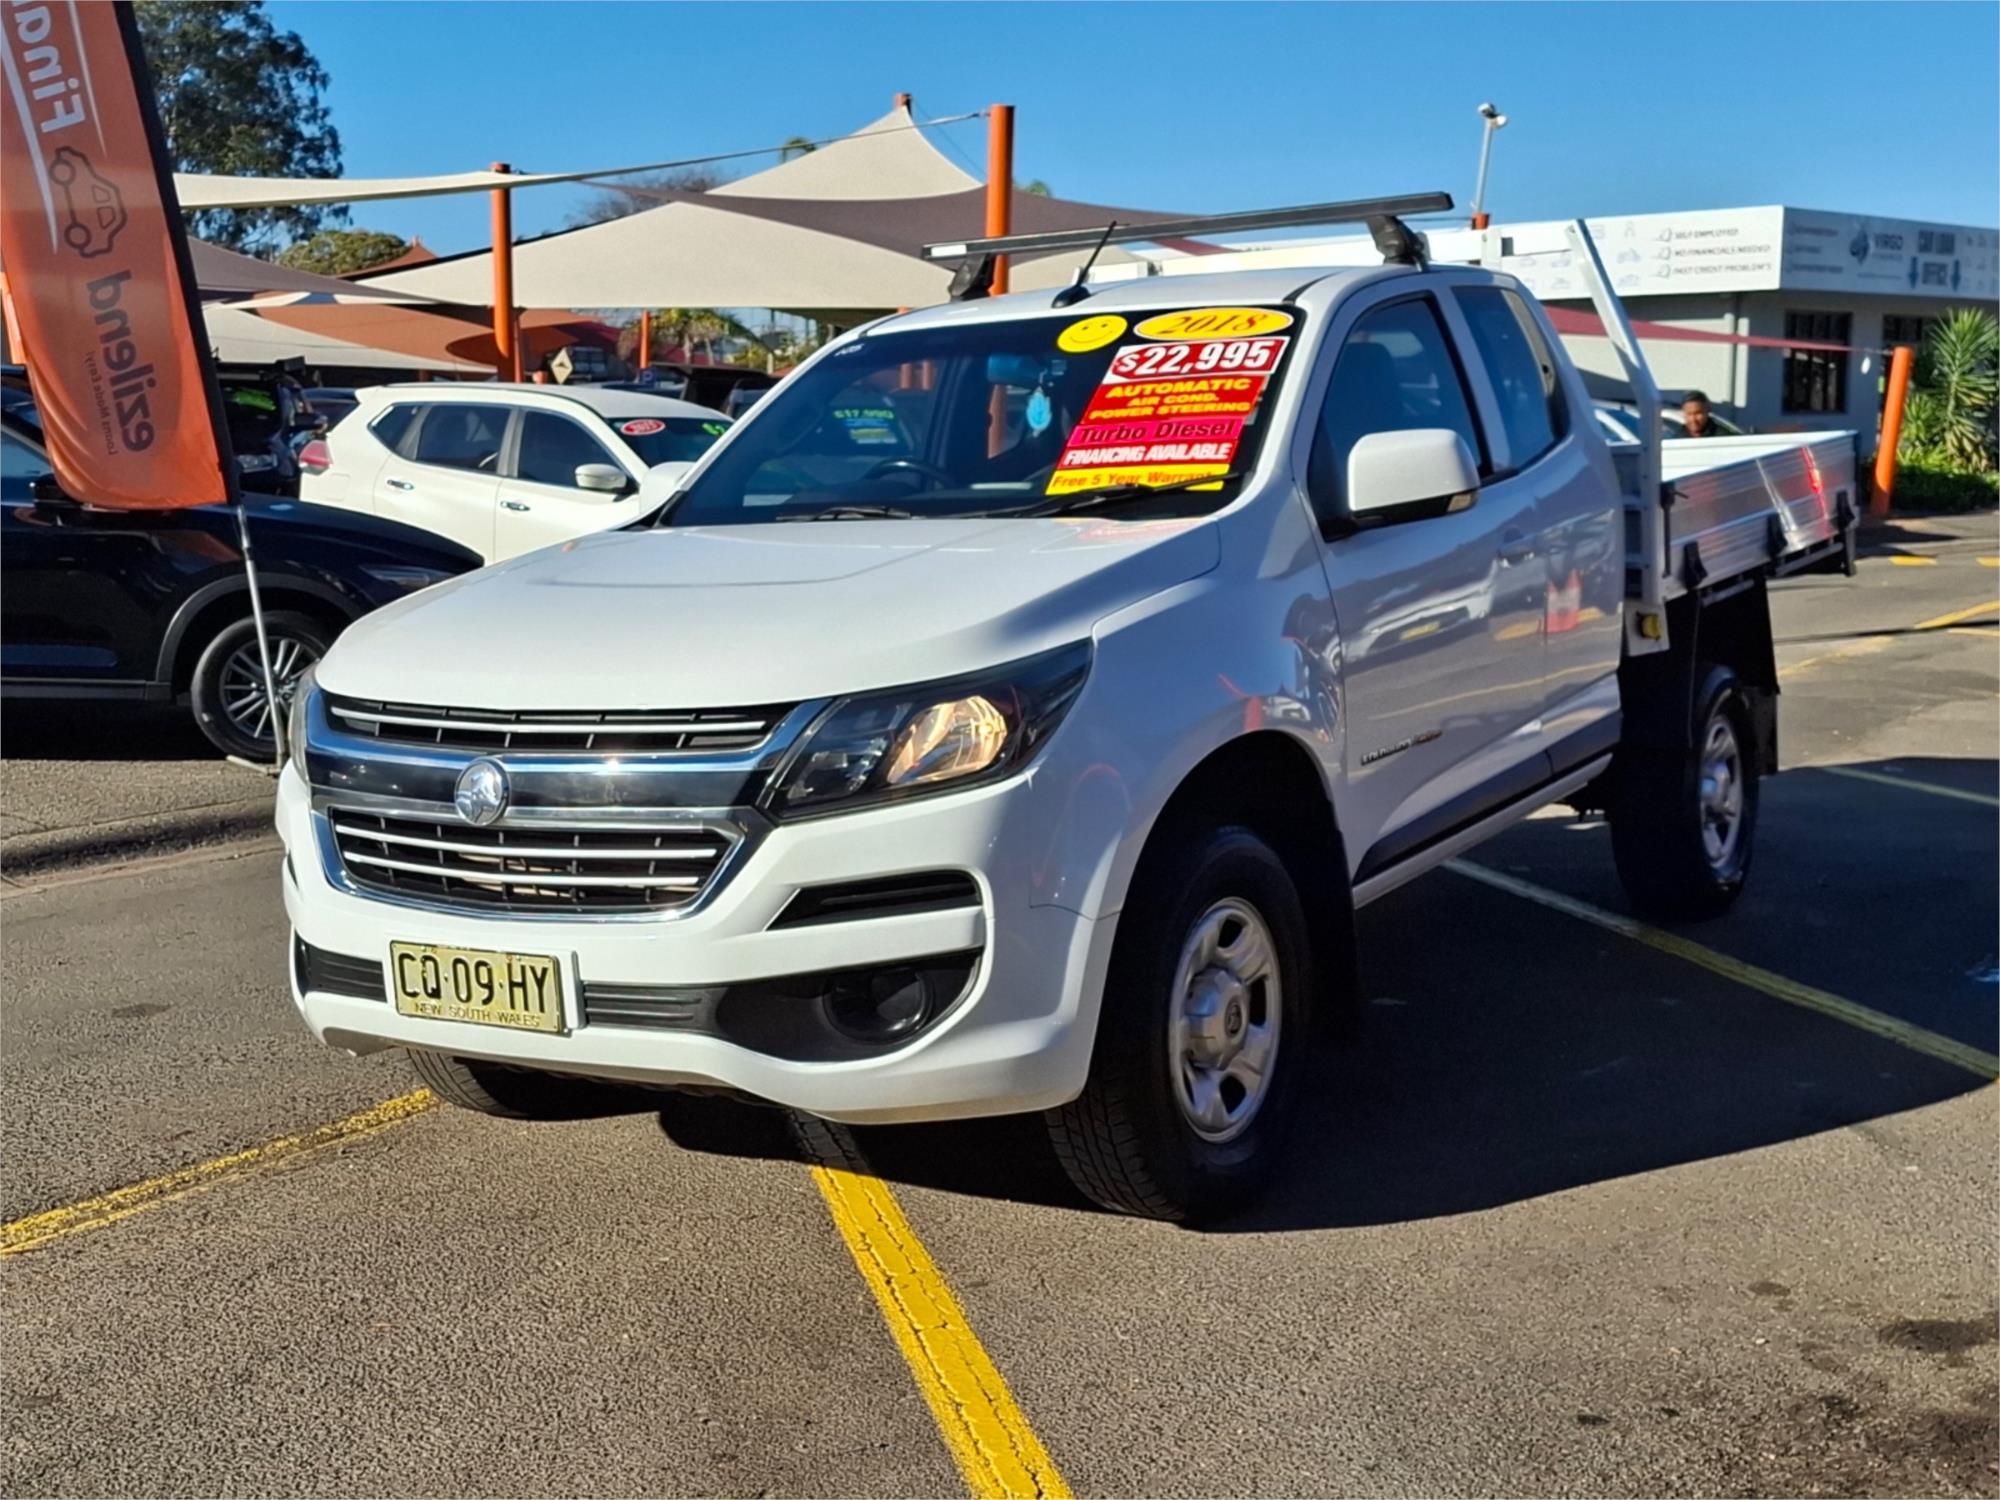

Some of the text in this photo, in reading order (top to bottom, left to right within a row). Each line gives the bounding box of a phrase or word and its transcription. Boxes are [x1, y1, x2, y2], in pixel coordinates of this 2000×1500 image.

[1157, 313, 1269, 335] 2018
[1117, 340, 1276, 376] $22,995
[1105, 378, 1252, 398] AUTOMATIC
[1089, 402, 1252, 420] POWER STEERING
[1128, 397, 1160, 407] AIR
[1078, 425, 1147, 442] Turbo
[1064, 443, 1233, 466] FINANCING AVAILABLE
[1053, 475, 1087, 487] Free
[1091, 473, 1101, 485] 5
[1108, 472, 1141, 486] Year
[414, 1002, 542, 1028] NEW SOUTH WALES
